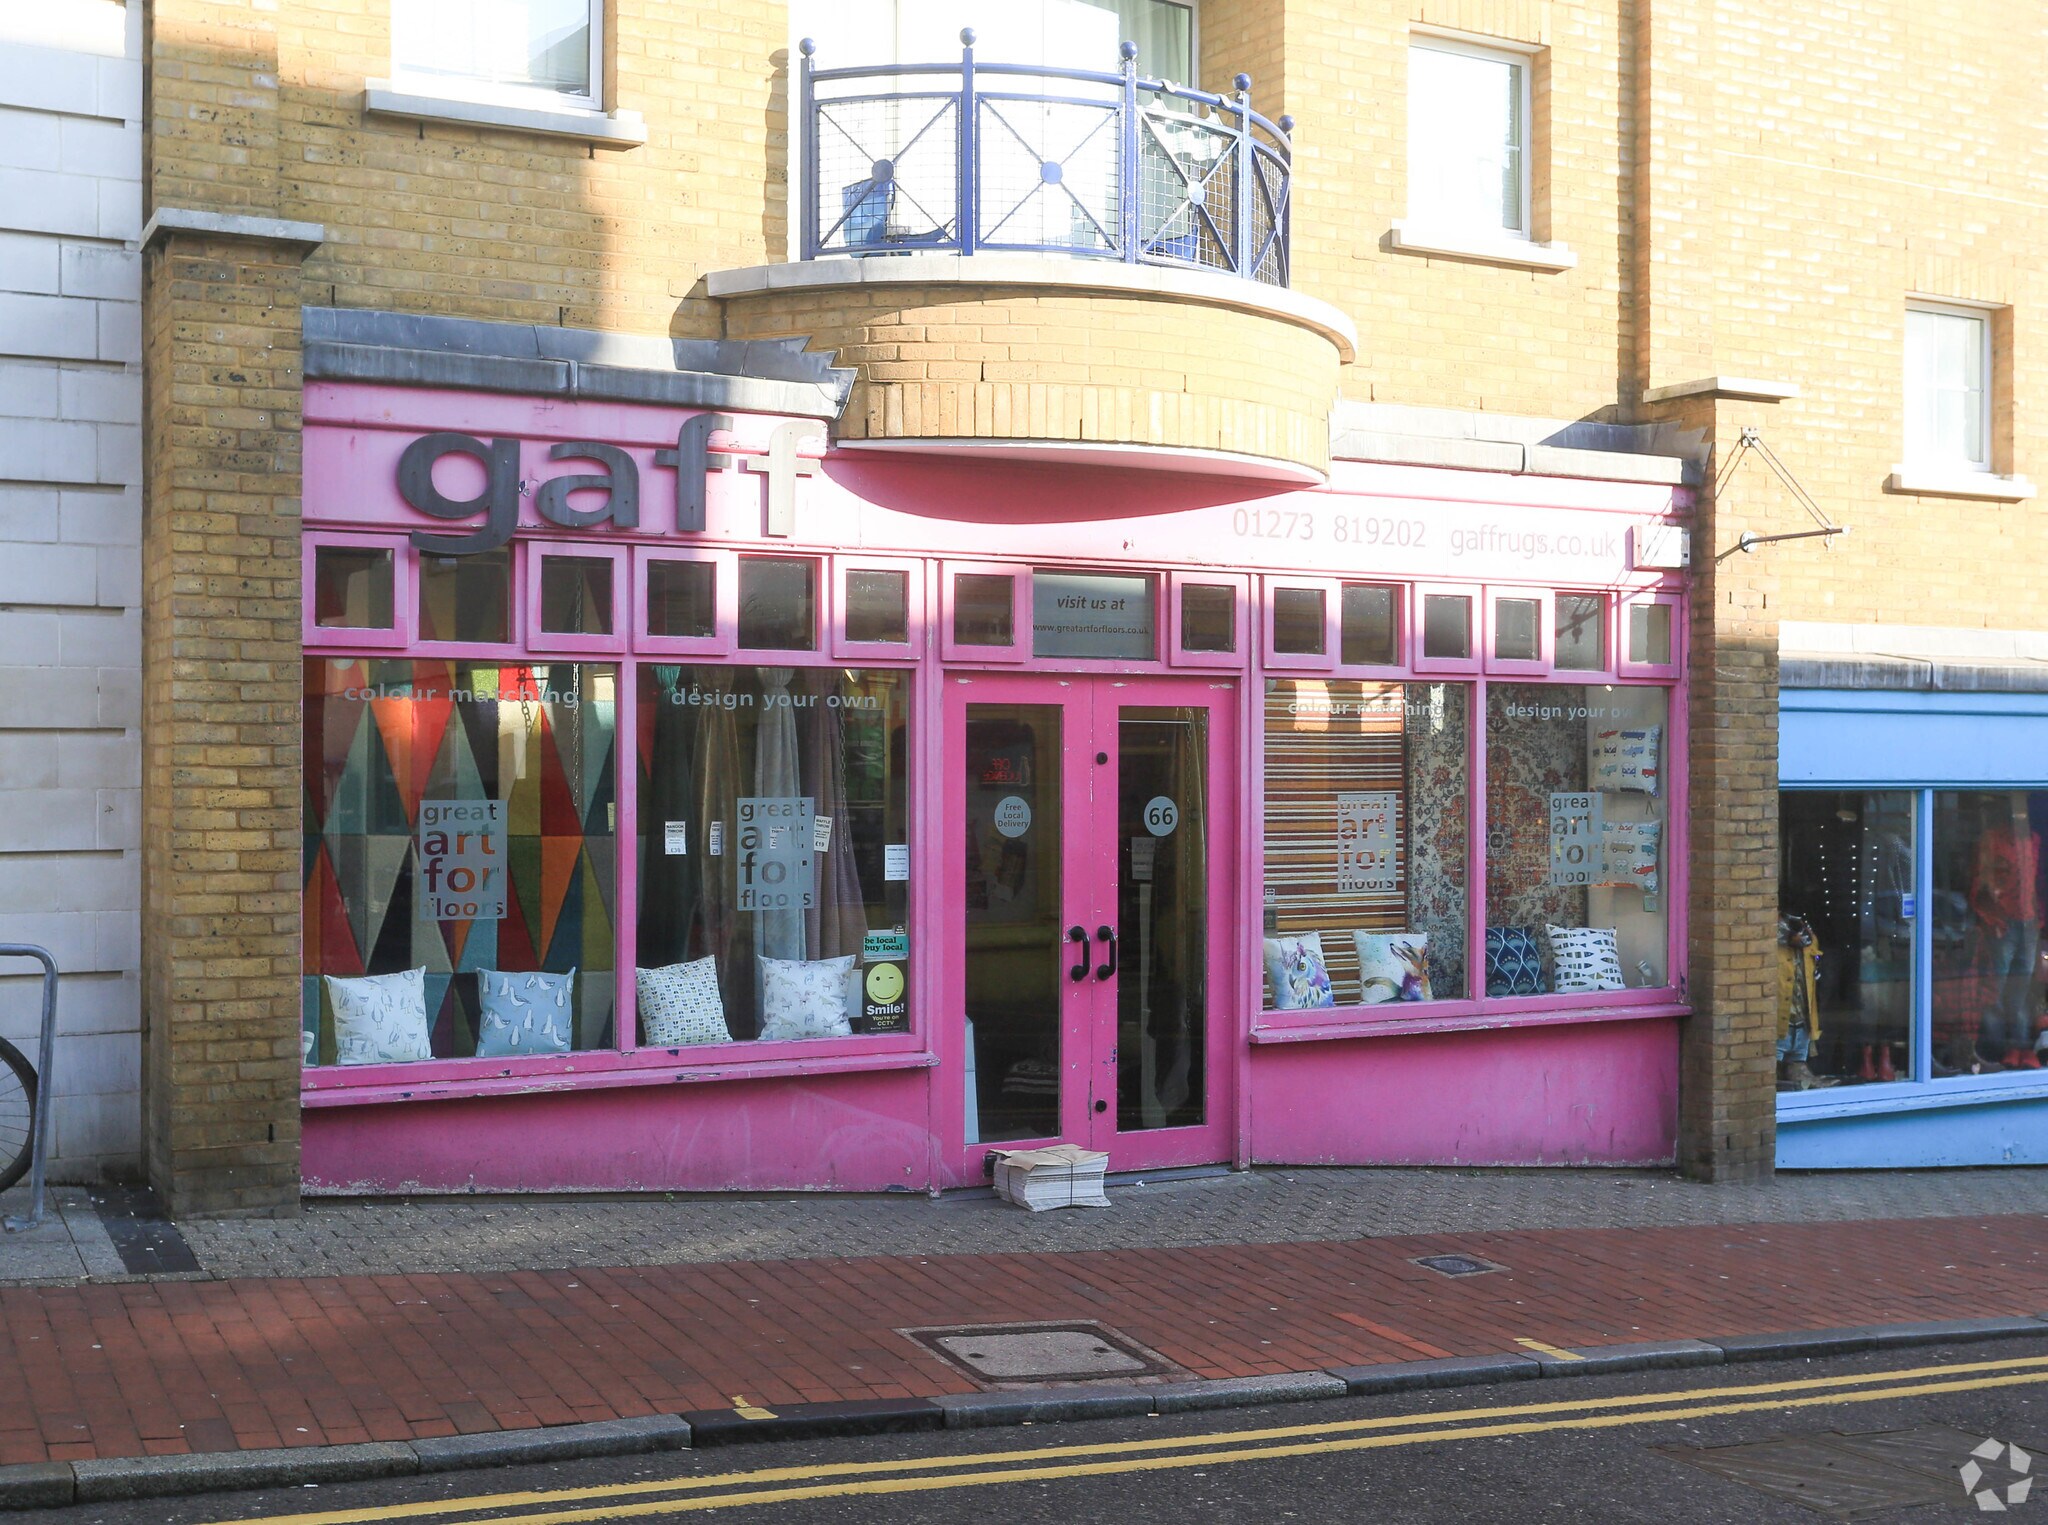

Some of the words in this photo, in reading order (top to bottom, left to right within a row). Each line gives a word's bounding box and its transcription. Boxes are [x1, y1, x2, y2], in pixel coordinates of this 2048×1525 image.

[396, 413, 824, 555] gaff
[1233, 508, 1315, 540] 01273
[1334, 515, 1427, 548] 819202
[1450, 523, 1618, 561] gaffrugs.co.uk
[1057, 595, 1087, 609] visit
[1091, 599, 1107, 610] us
[1111, 597, 1126, 611] at
[1033, 623, 1149, 635] www.greatartforfloors.co.uk
[344, 682, 437, 702] colour
[448, 684, 579, 708] matching
[671, 687, 754, 712] design
[763, 692, 819, 712] your
[826, 692, 878, 709] own
[1288, 698, 1350, 715] colour
[1357, 700, 1445, 719] matching
[1505, 702, 1562, 721] design
[1568, 706, 1606, 721] your
[1611, 708, 1641, 719] ow
[423, 803, 498, 826] great
[740, 800, 806, 822] great
[1005, 803, 1022, 811] Free
[1340, 796, 1387, 816] great
[1552, 795, 1596, 813] great
[997, 820, 1029, 829] Delivery
[1003, 811, 1024, 819] Local
[1149, 807, 1174, 826] 66
[1552, 811, 1595, 836] art
[1340, 813, 1388, 840] art
[423, 824, 496, 857] art
[1554, 836, 1599, 864] for
[1340, 841, 1392, 870] for
[423, 857, 500, 894] for
[740, 889, 812, 908] floos
[864, 944, 881, 952] buy
[883, 943, 903, 951] local
[866, 1003, 905, 1016] Smile!
